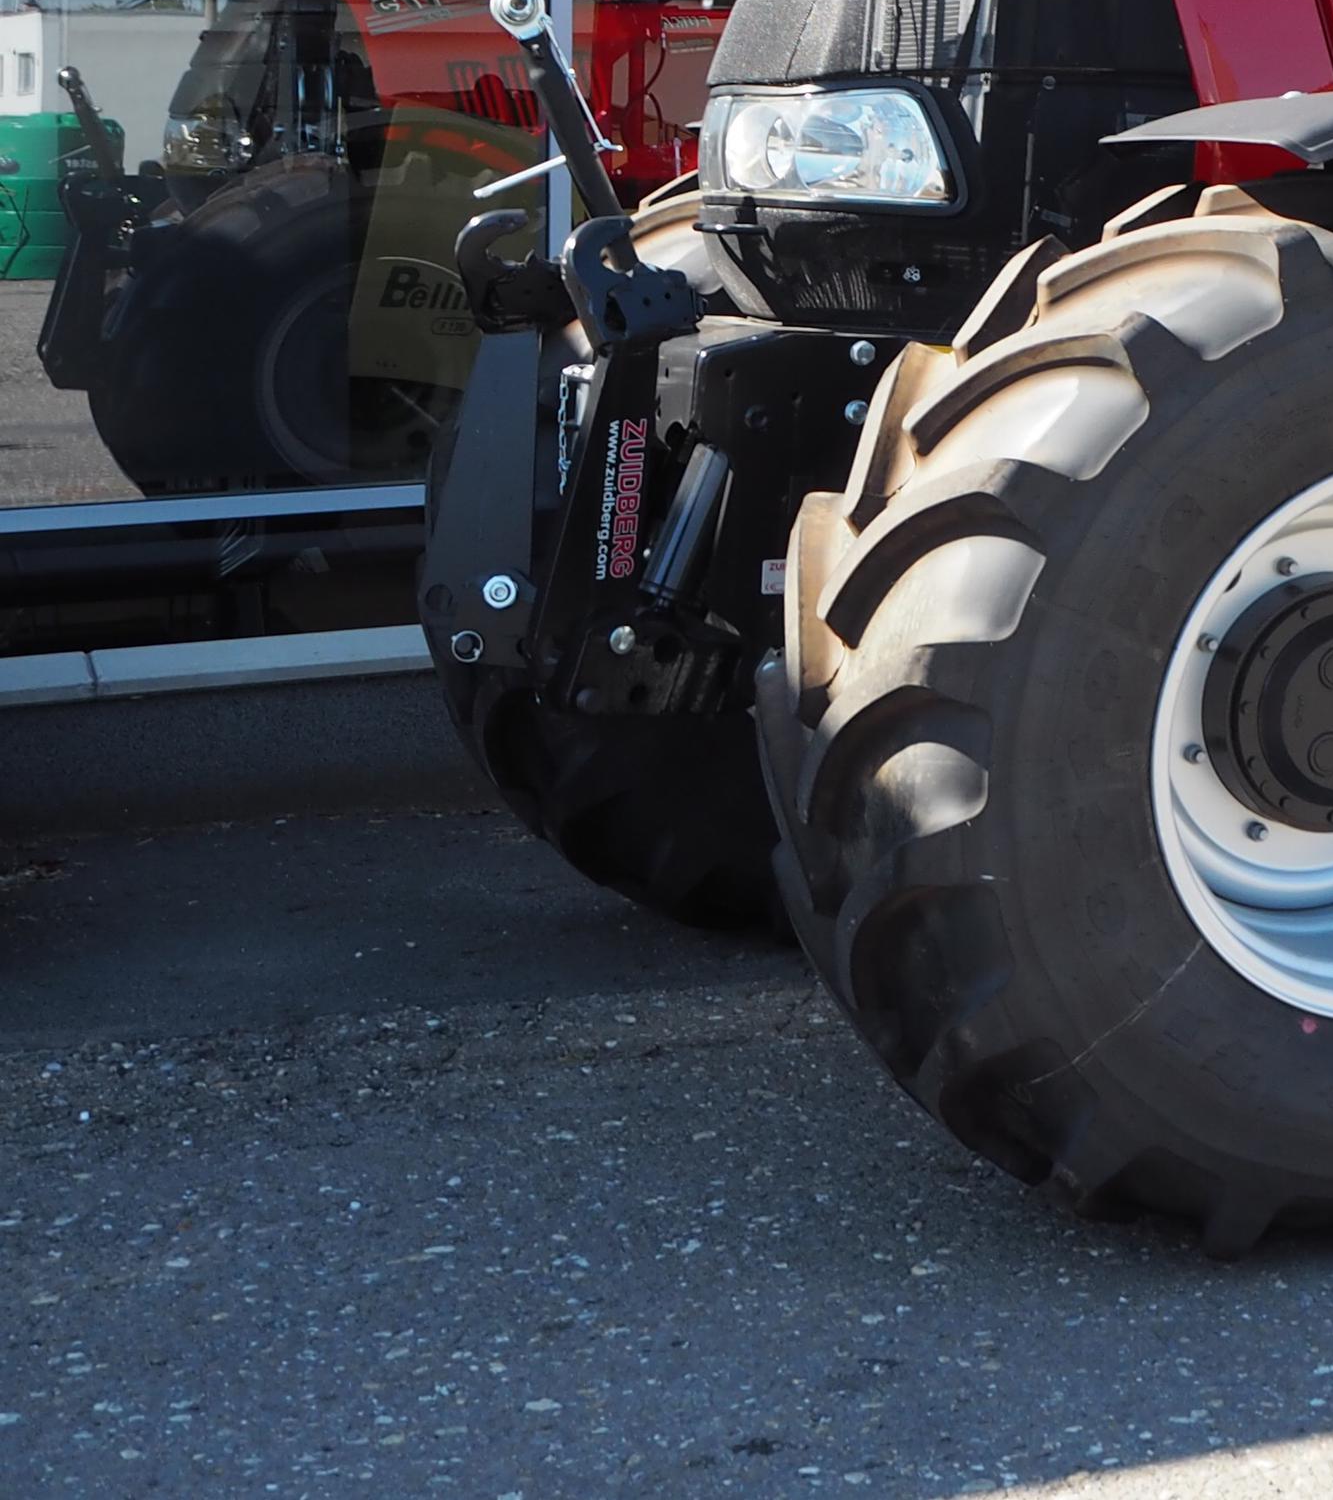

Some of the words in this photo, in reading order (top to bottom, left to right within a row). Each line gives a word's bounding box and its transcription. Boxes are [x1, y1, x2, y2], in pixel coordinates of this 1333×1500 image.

[377, 265, 470, 310] Belli
[594, 418, 621, 581] www.zuidberg.com
[609, 417, 648, 579] ZUIDBERG
